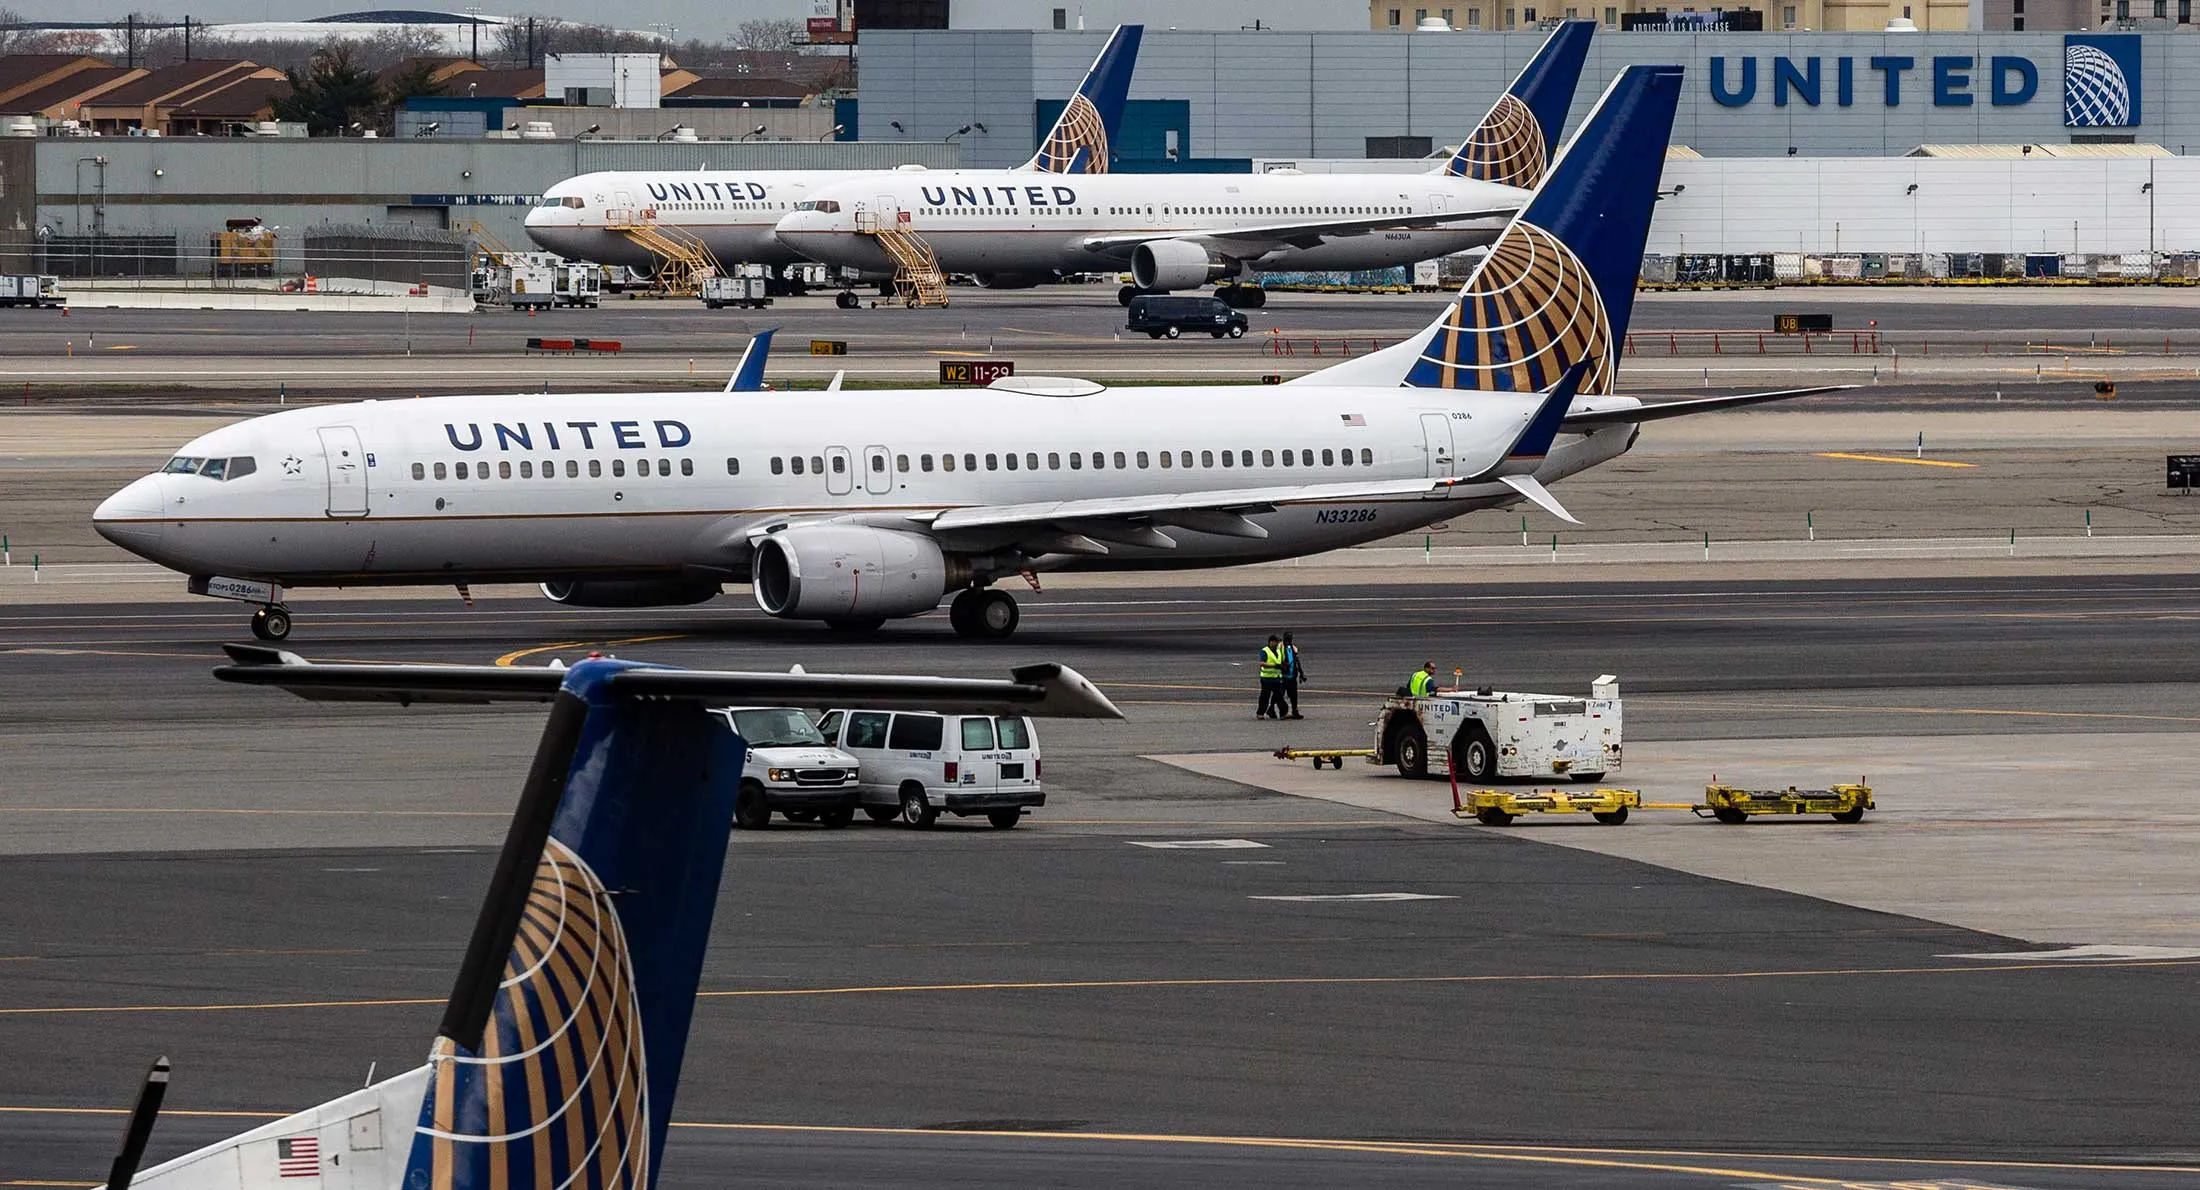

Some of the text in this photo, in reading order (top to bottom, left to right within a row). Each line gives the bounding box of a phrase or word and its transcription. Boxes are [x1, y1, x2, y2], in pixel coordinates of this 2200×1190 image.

[1678, 22, 1686, 31] IS
[1689, 22, 1693, 31] A
[1696, 21, 1729, 31] DISEASE
[1710, 55, 2039, 107] UNITED
[646, 182, 767, 201] UNITED
[921, 186, 1077, 206] UNITED
[1782, 318, 1796, 329] UB
[946, 366, 1009, 380] W2 11-29
[444, 420, 692, 451] UNITED
[1316, 509, 1377, 524] N33286
[229, 583, 252, 594] 0286
[1418, 703, 1451, 712] UNITED
[746, 751, 752, 763] 5
